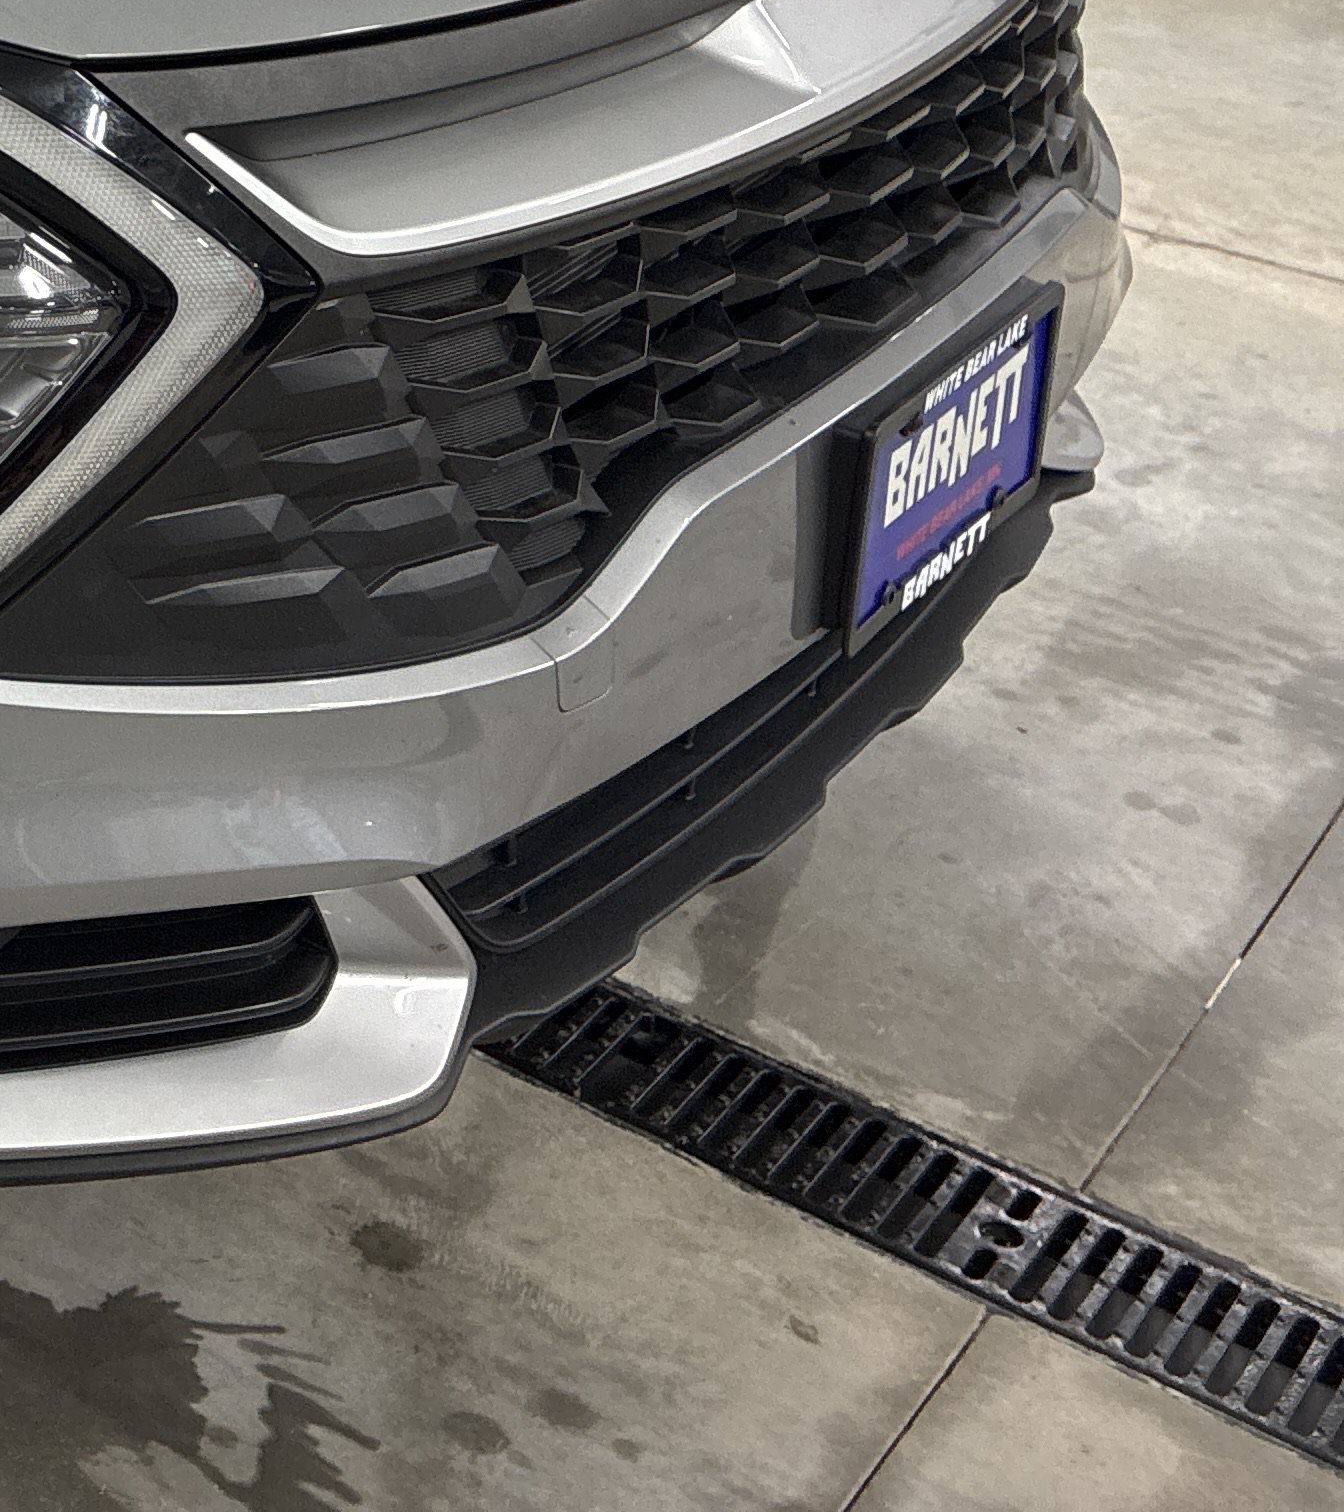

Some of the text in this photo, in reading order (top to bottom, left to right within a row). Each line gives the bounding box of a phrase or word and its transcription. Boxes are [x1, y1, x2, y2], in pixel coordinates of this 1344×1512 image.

[923, 313, 1029, 414] WHITE BEAR LAKE
[883, 342, 1030, 529] BARNETT
[900, 511, 992, 613] BARNETT
